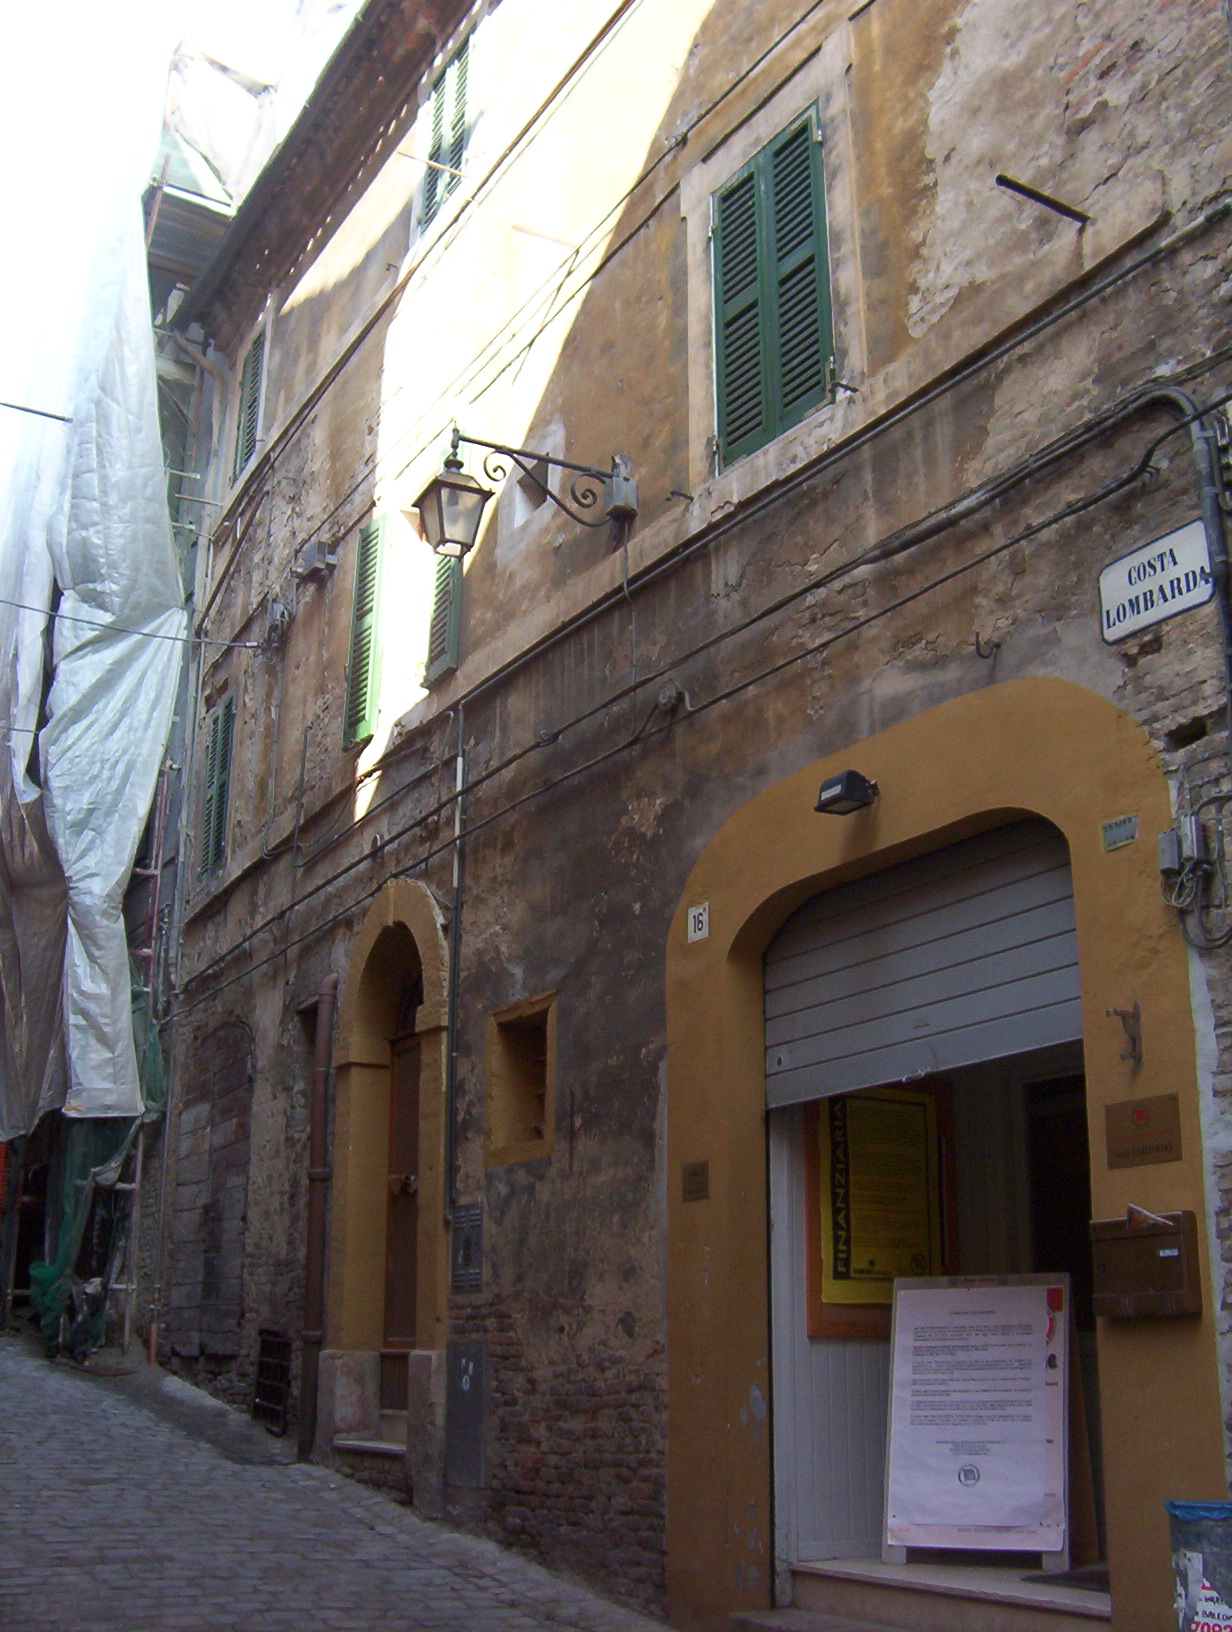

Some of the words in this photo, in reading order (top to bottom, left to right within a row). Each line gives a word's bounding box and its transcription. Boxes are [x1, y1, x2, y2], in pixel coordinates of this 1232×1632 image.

[1106, 566, 1211, 630] LOMBARDA
[1128, 548, 1178, 586] COSTA
[833, 1101, 848, 1273] FINANZIARIA
